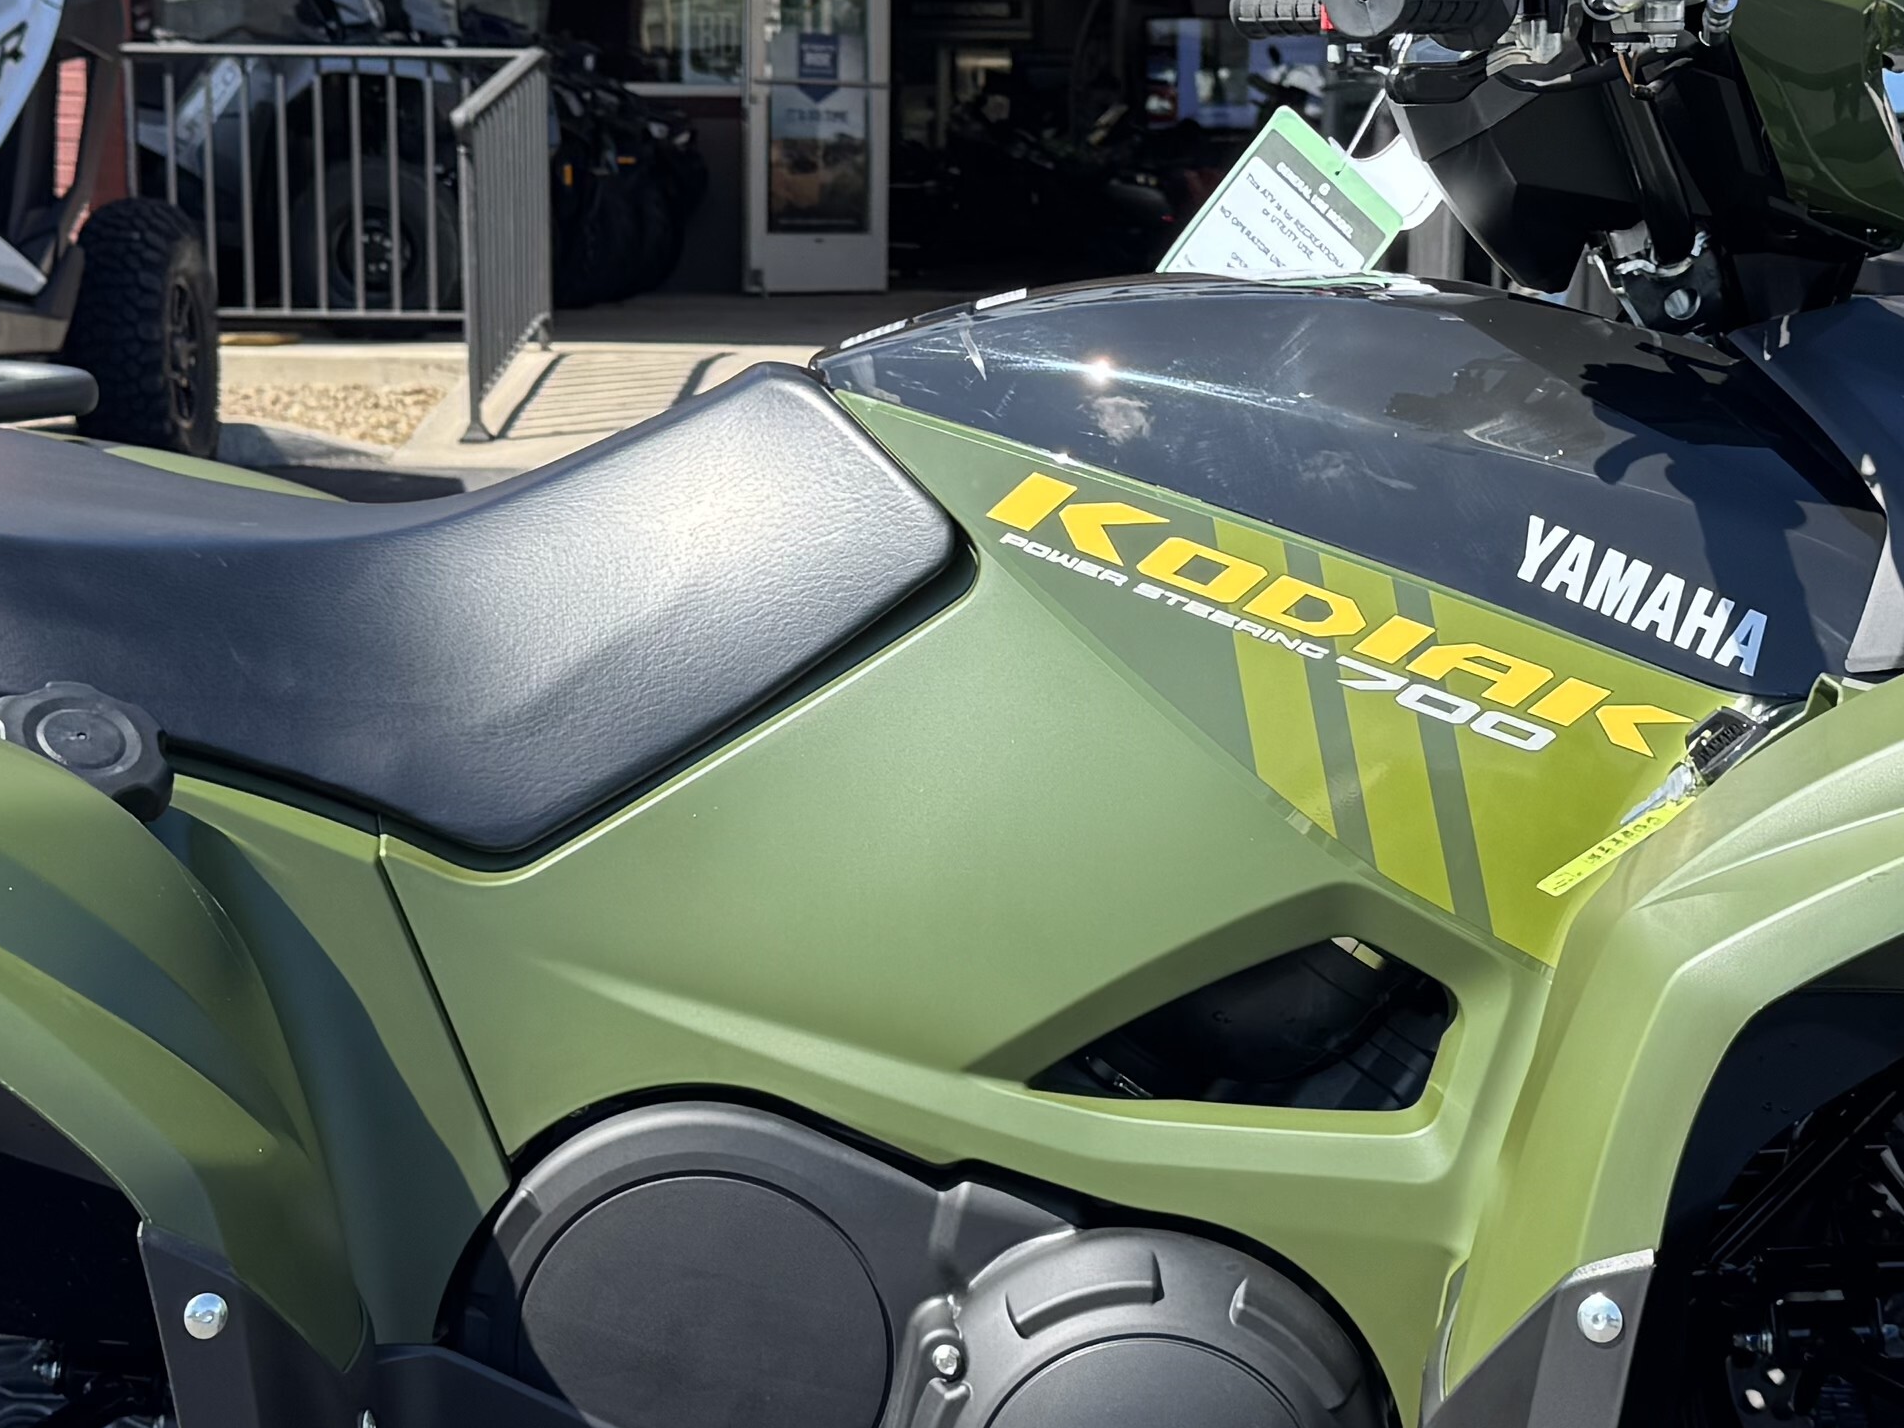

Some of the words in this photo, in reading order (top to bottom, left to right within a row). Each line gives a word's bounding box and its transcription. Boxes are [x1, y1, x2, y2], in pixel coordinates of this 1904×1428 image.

[985, 472, 1695, 758] KODIAK
[999, 522, 1129, 587] POWER
[1132, 582, 1329, 659] STEERING
[1516, 515, 1768, 676] YAMAHA
[1335, 657, 1557, 751] 700
